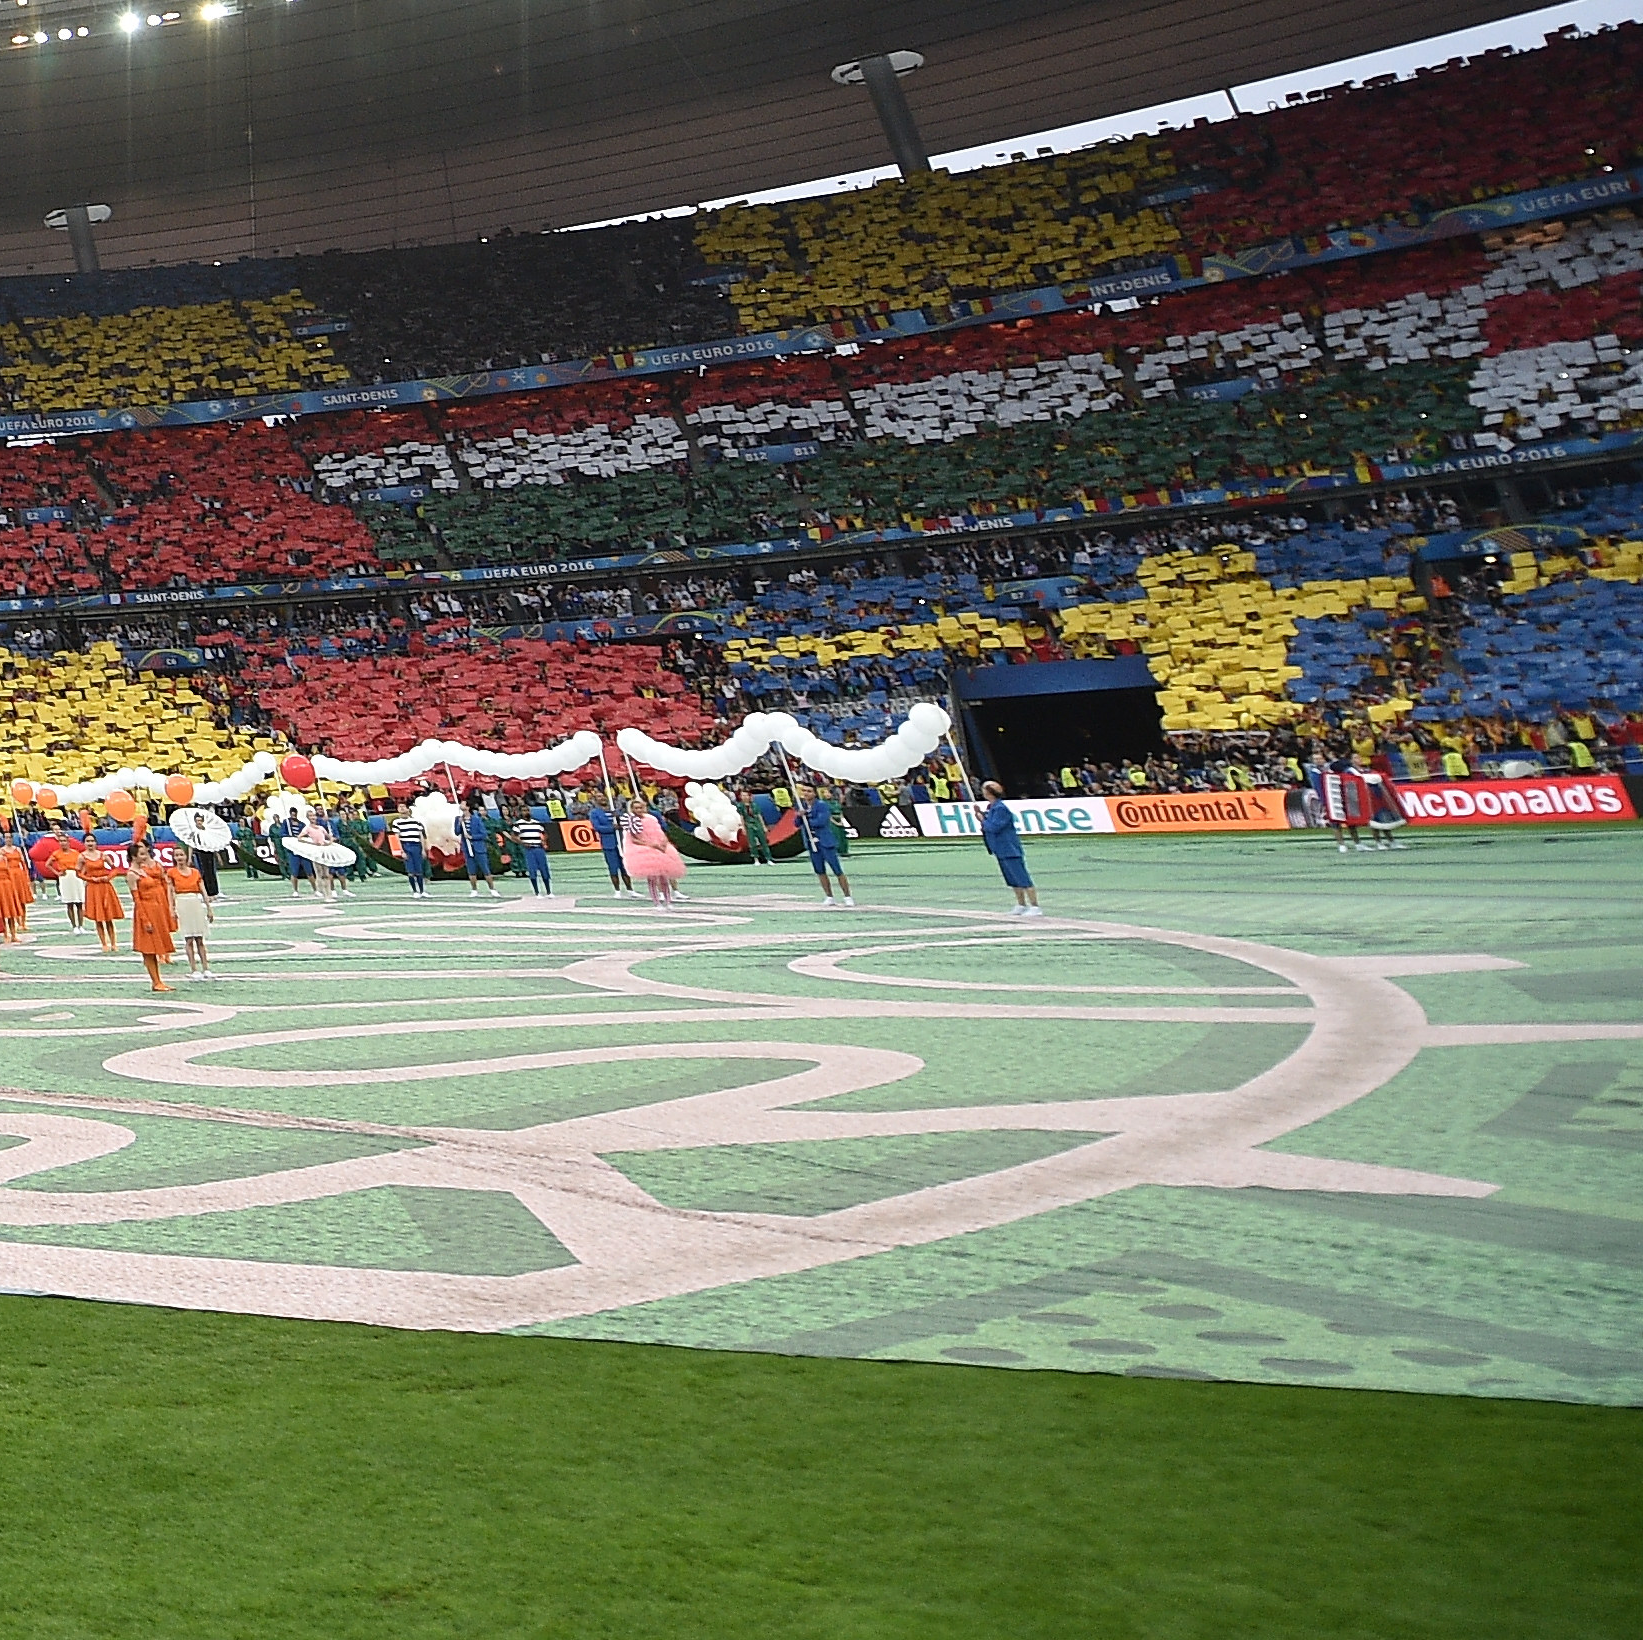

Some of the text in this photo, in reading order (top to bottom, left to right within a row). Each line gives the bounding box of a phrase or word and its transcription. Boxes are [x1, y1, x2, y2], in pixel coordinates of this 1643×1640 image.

[1520, 192, 1578, 212] UEFA
[1089, 272, 1172, 297] INT-DENIS
[651, 339, 775, 365] UEFA EURO 2016
[322, 388, 399, 406] SAINT-DENIS
[31, 416, 64, 429] EURO
[65, 415, 96, 426] 2016
[1403, 445, 1566, 478] UEFA EURO 2016
[483, 560, 595, 580] UEFA EURO 2016
[135, 589, 205, 603] SAINT-DENIS
[1117, 797, 1249, 828] Continental
[1398, 783, 1623, 818] McDonald's
[935, 803, 1094, 833] Hinse
